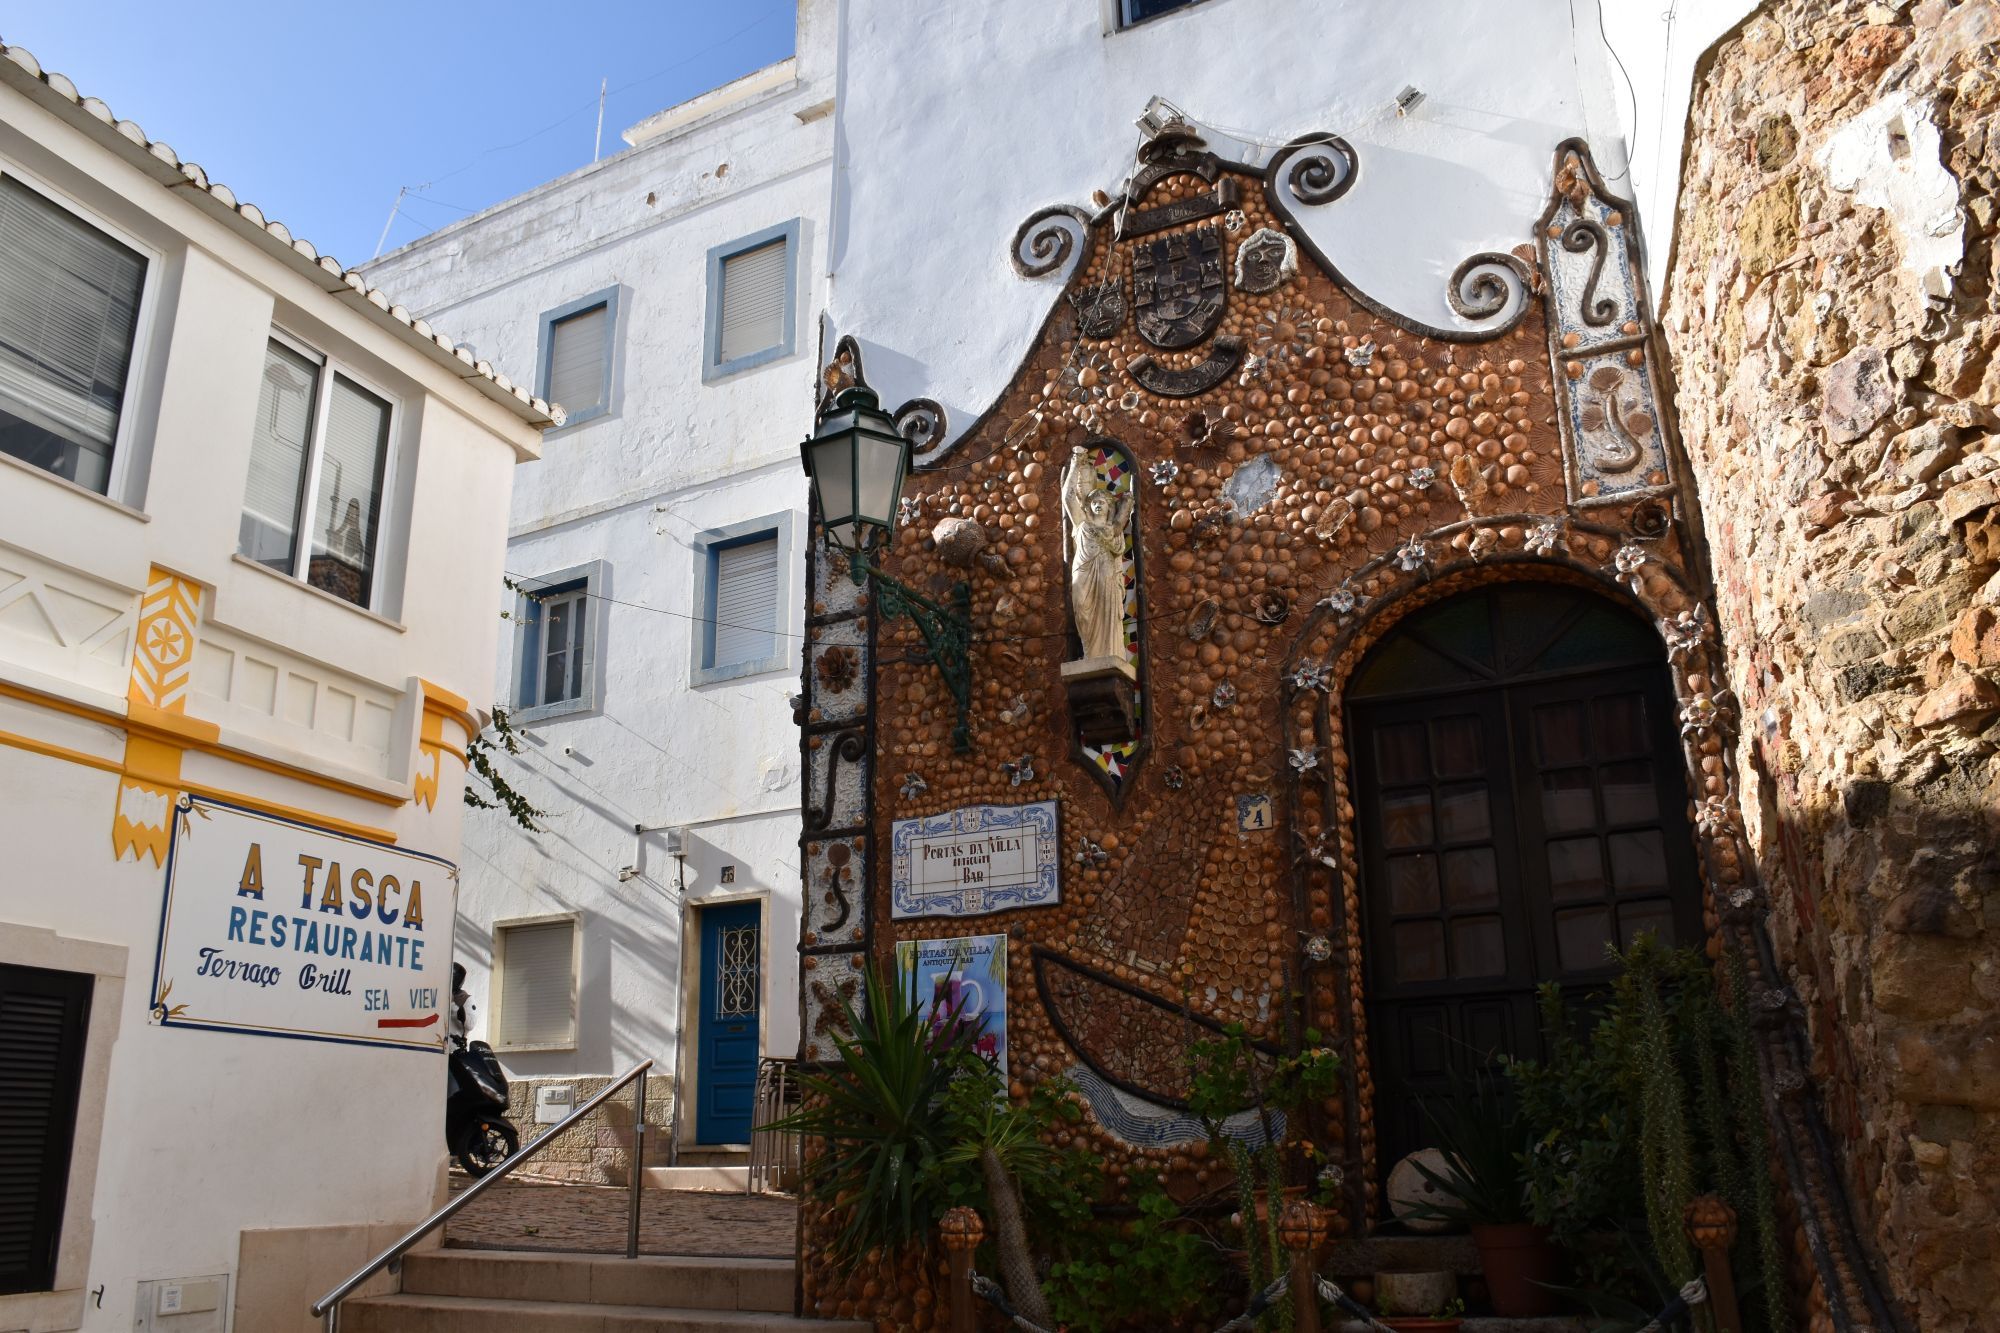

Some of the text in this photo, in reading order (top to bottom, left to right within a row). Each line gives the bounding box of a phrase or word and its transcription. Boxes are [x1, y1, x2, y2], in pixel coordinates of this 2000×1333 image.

[969, 843, 984, 855] DA
[236, 842, 424, 932] A TASCA
[227, 905, 425, 971] RESTAURANTE
[197, 946, 352, 996] Terraço Grill
[364, 988, 439, 1011] SEA VIEW
